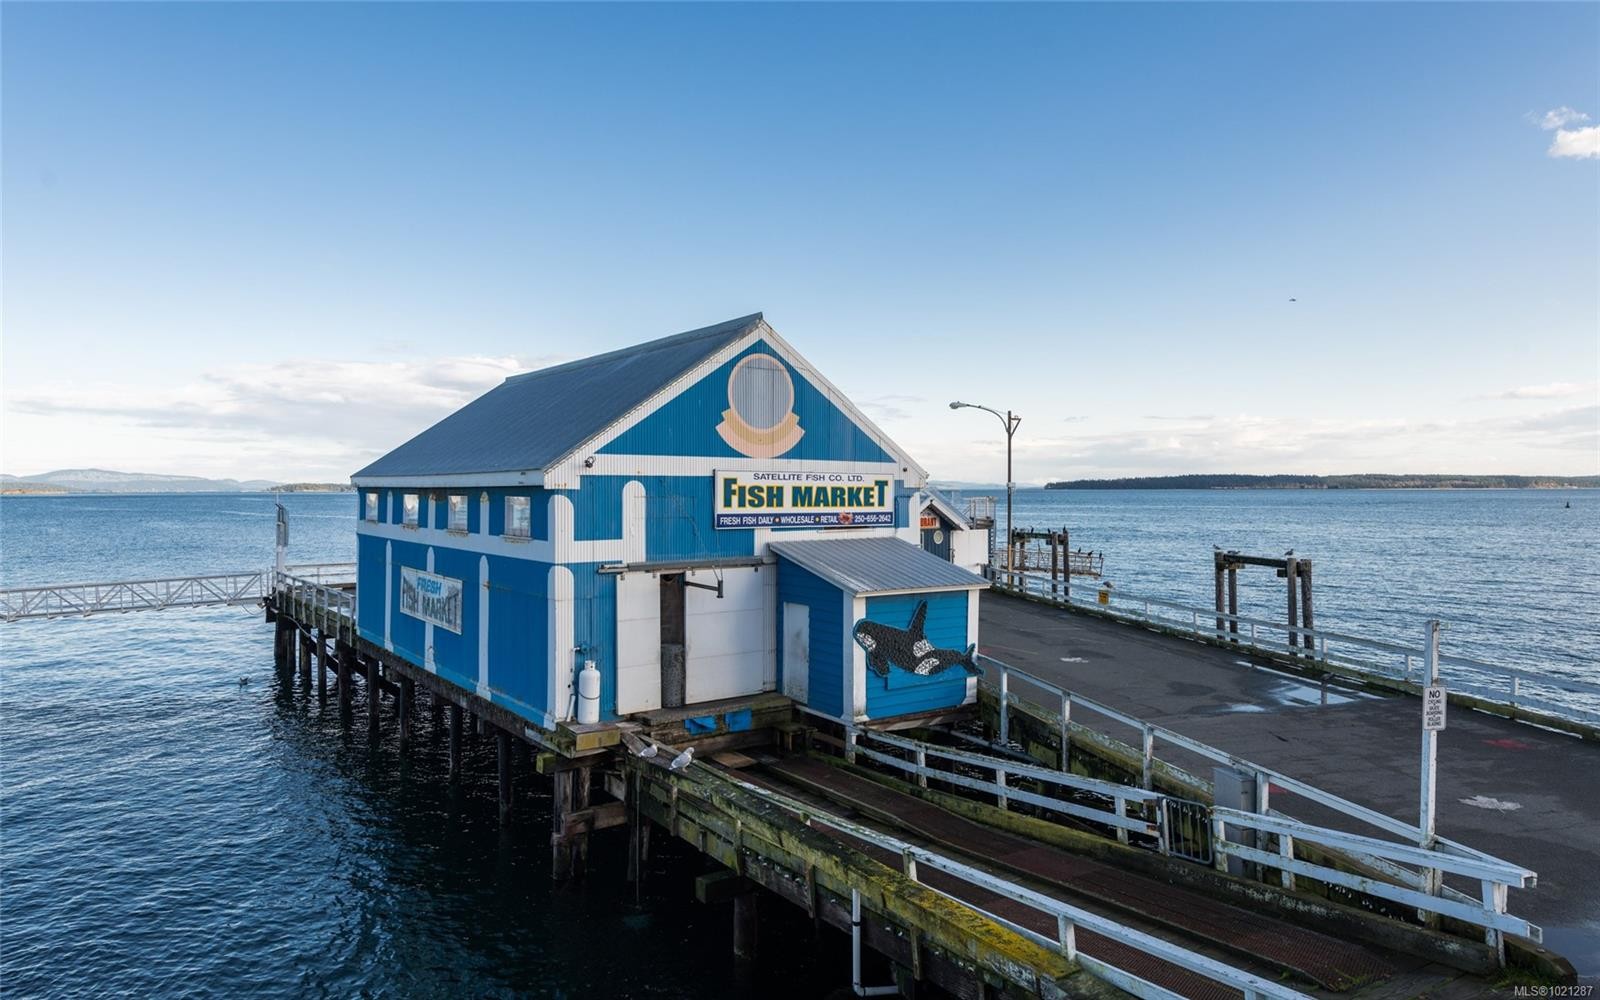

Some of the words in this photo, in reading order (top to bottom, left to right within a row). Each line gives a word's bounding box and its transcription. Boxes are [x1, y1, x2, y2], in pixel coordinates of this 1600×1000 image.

[753, 472, 803, 481] SATELLITE
[805, 474, 825, 482] FISH
[828, 474, 844, 482] CO.
[723, 477, 785, 509] FISH
[791, 479, 889, 508] MARKET
[720, 516, 741, 525] FRESH
[742, 516, 757, 525] FISH
[758, 516, 774, 525] DAILY
[780, 515, 815, 524] WHOLESALE
[820, 515, 838, 524] RETAIL
[416, 577, 442, 596] FRESH
[1429, 690, 1440, 698] NO
